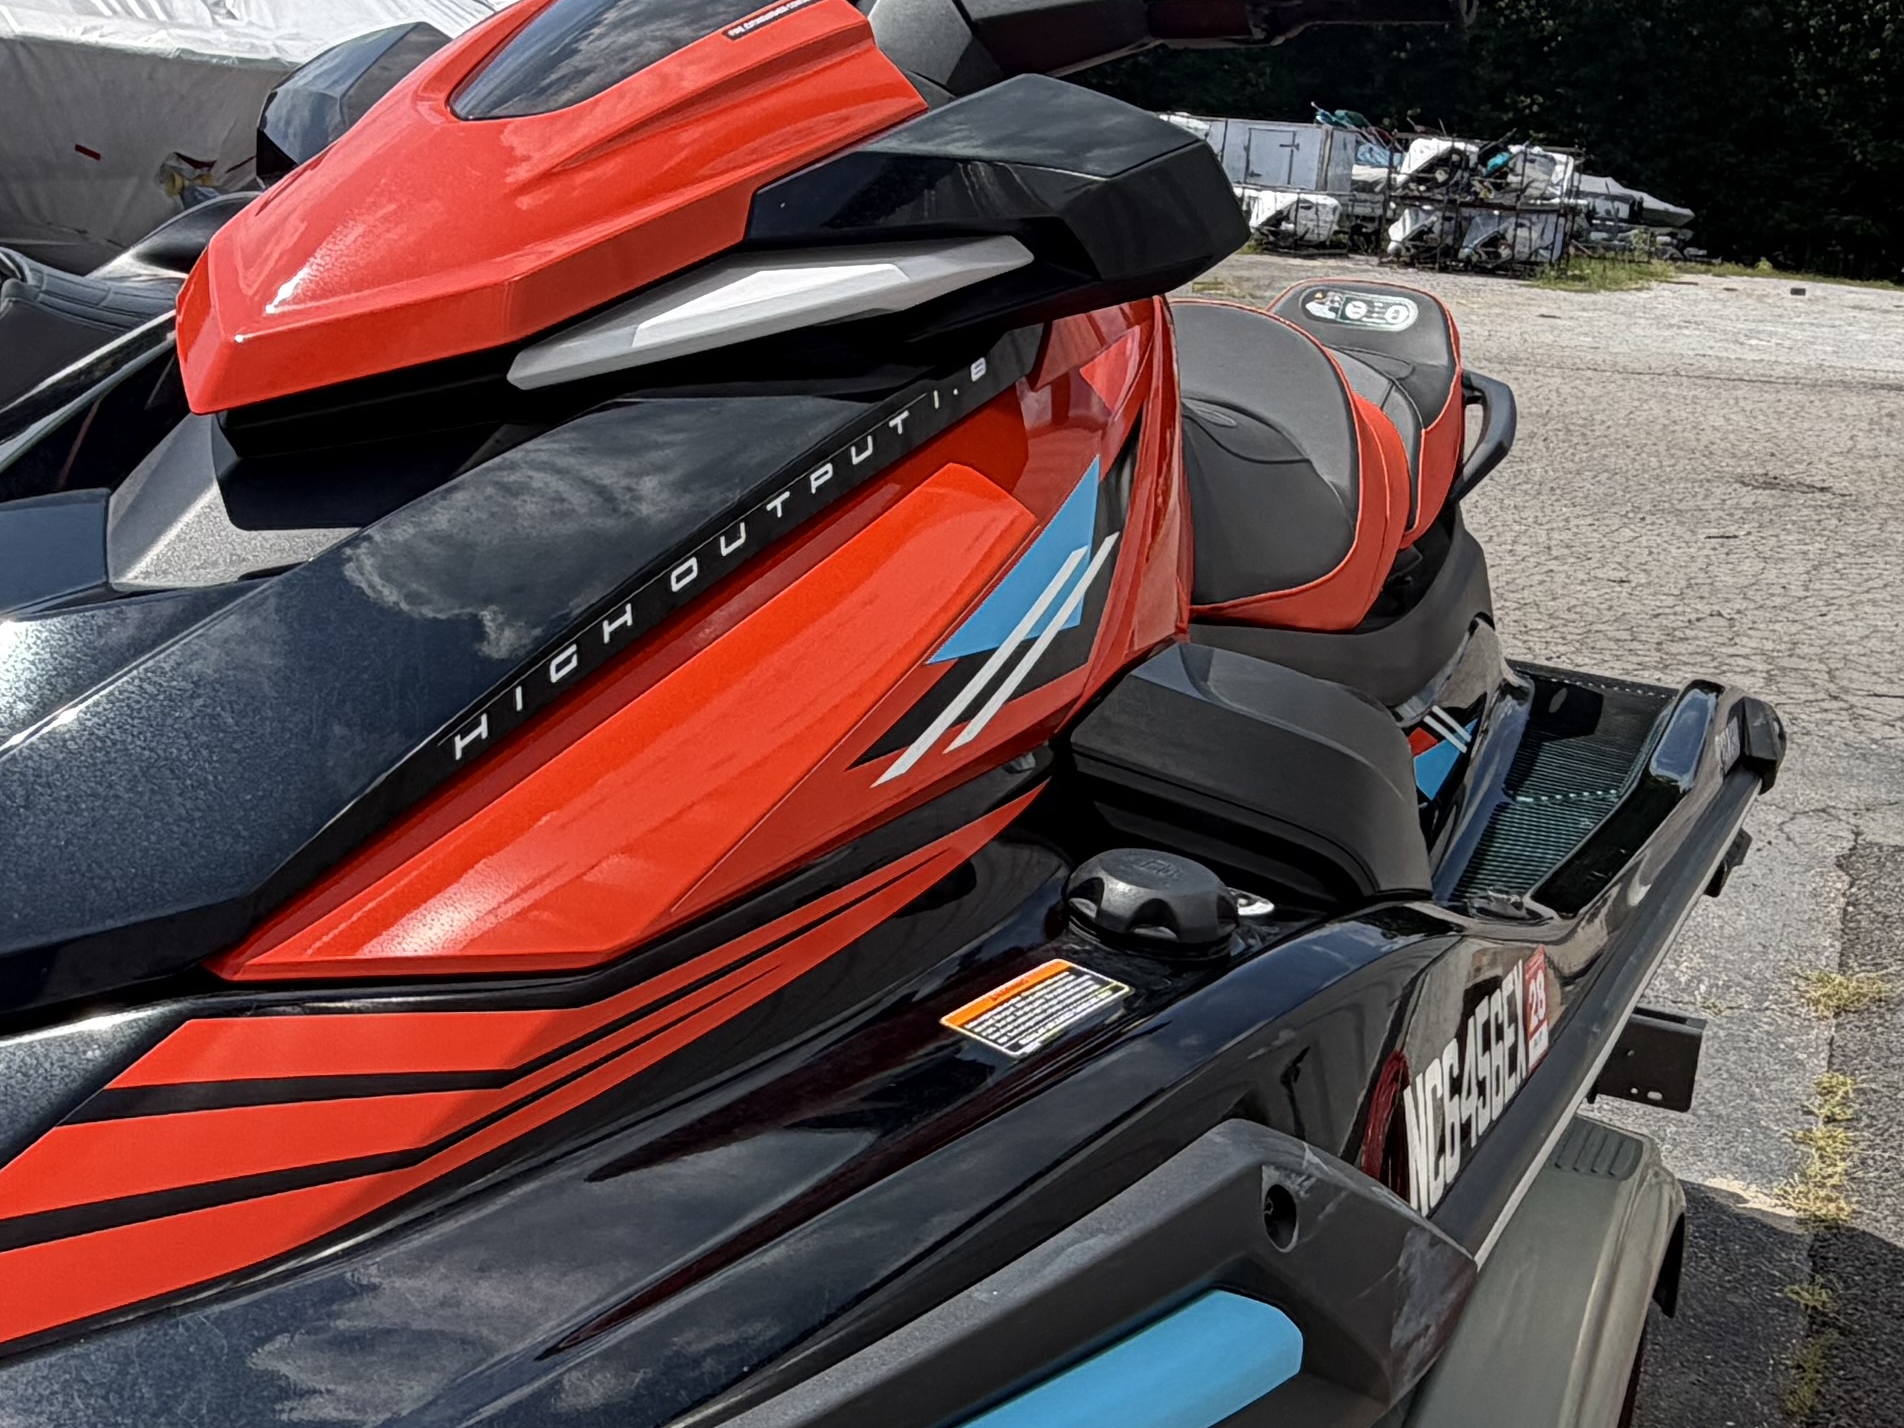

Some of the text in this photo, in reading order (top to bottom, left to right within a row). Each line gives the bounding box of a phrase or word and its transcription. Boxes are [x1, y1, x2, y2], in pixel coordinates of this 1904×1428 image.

[455, 357, 987, 760] HIGH OUTPUT 1.8
[1528, 969, 1546, 1034] 28
